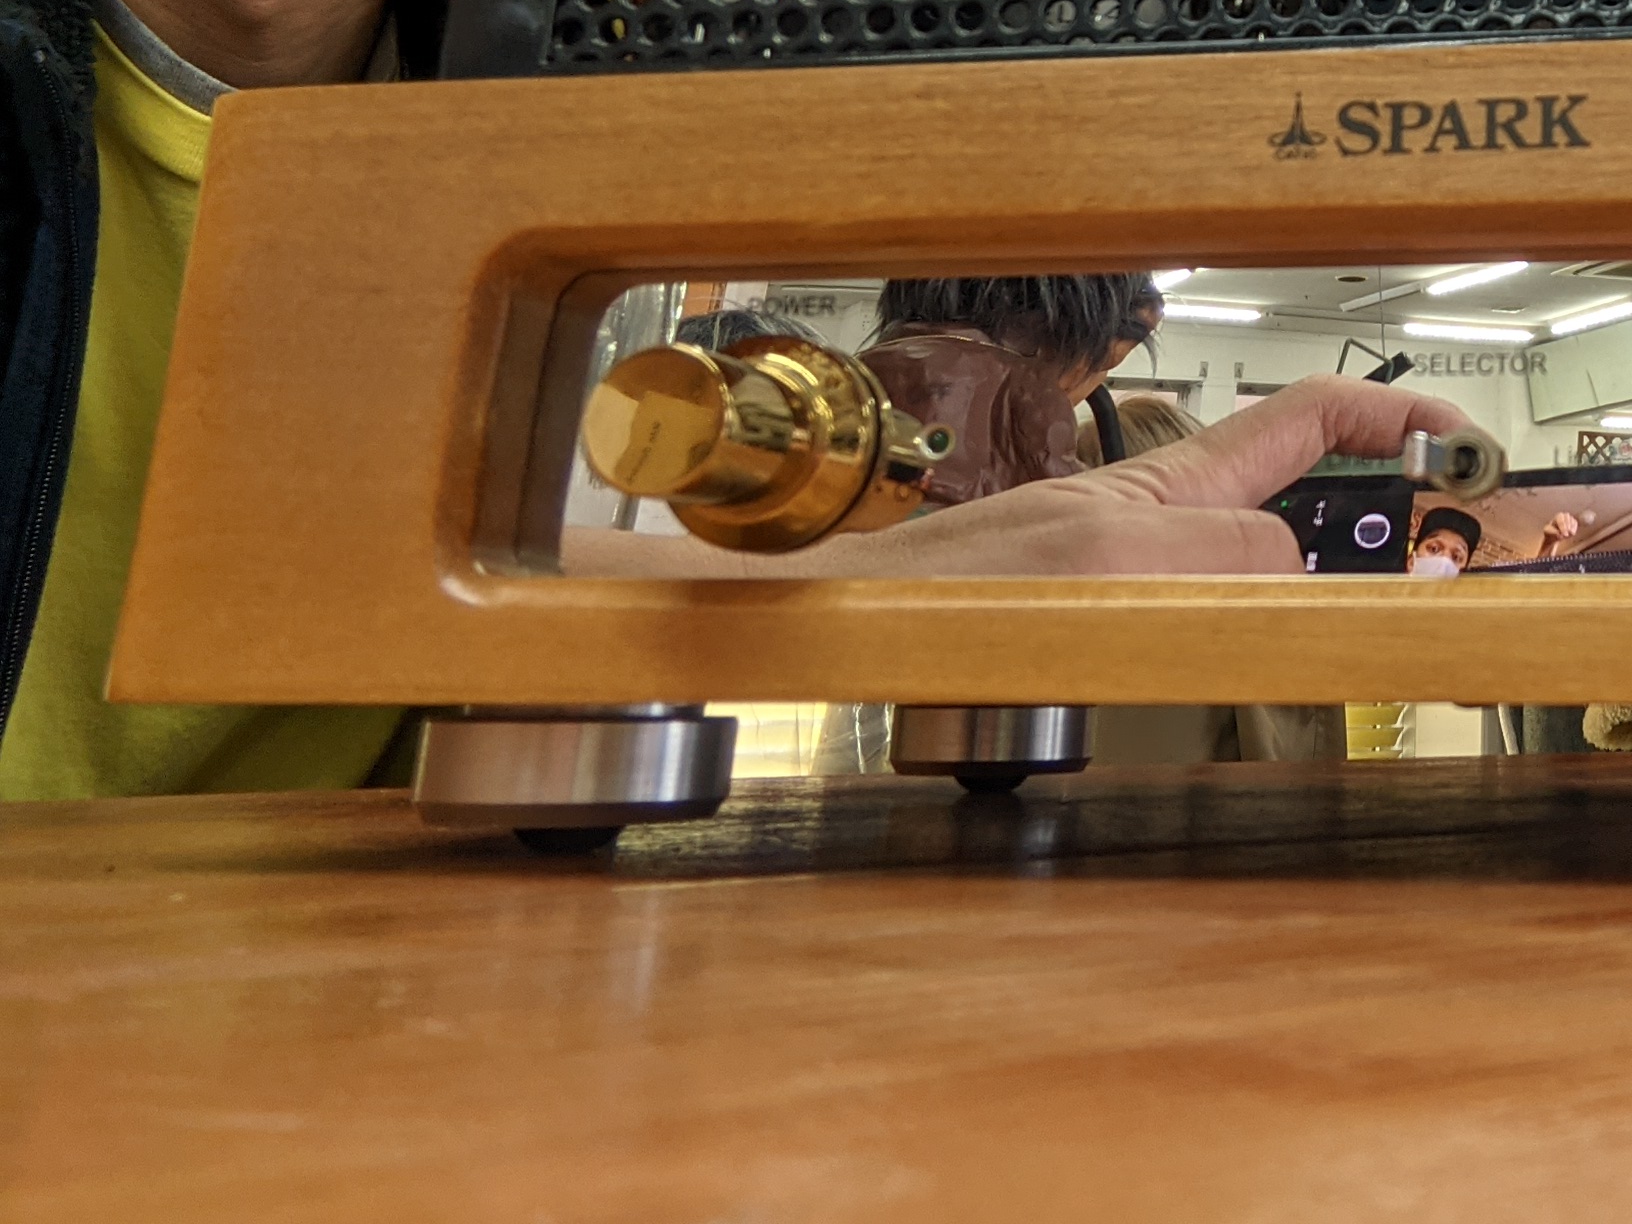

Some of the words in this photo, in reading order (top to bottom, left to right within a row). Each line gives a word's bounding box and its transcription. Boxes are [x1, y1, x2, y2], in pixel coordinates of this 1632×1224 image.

[1334, 94, 1591, 157] SPARK
[747, 296, 836, 317] POWER
[1413, 352, 1548, 377] SELECTOR
